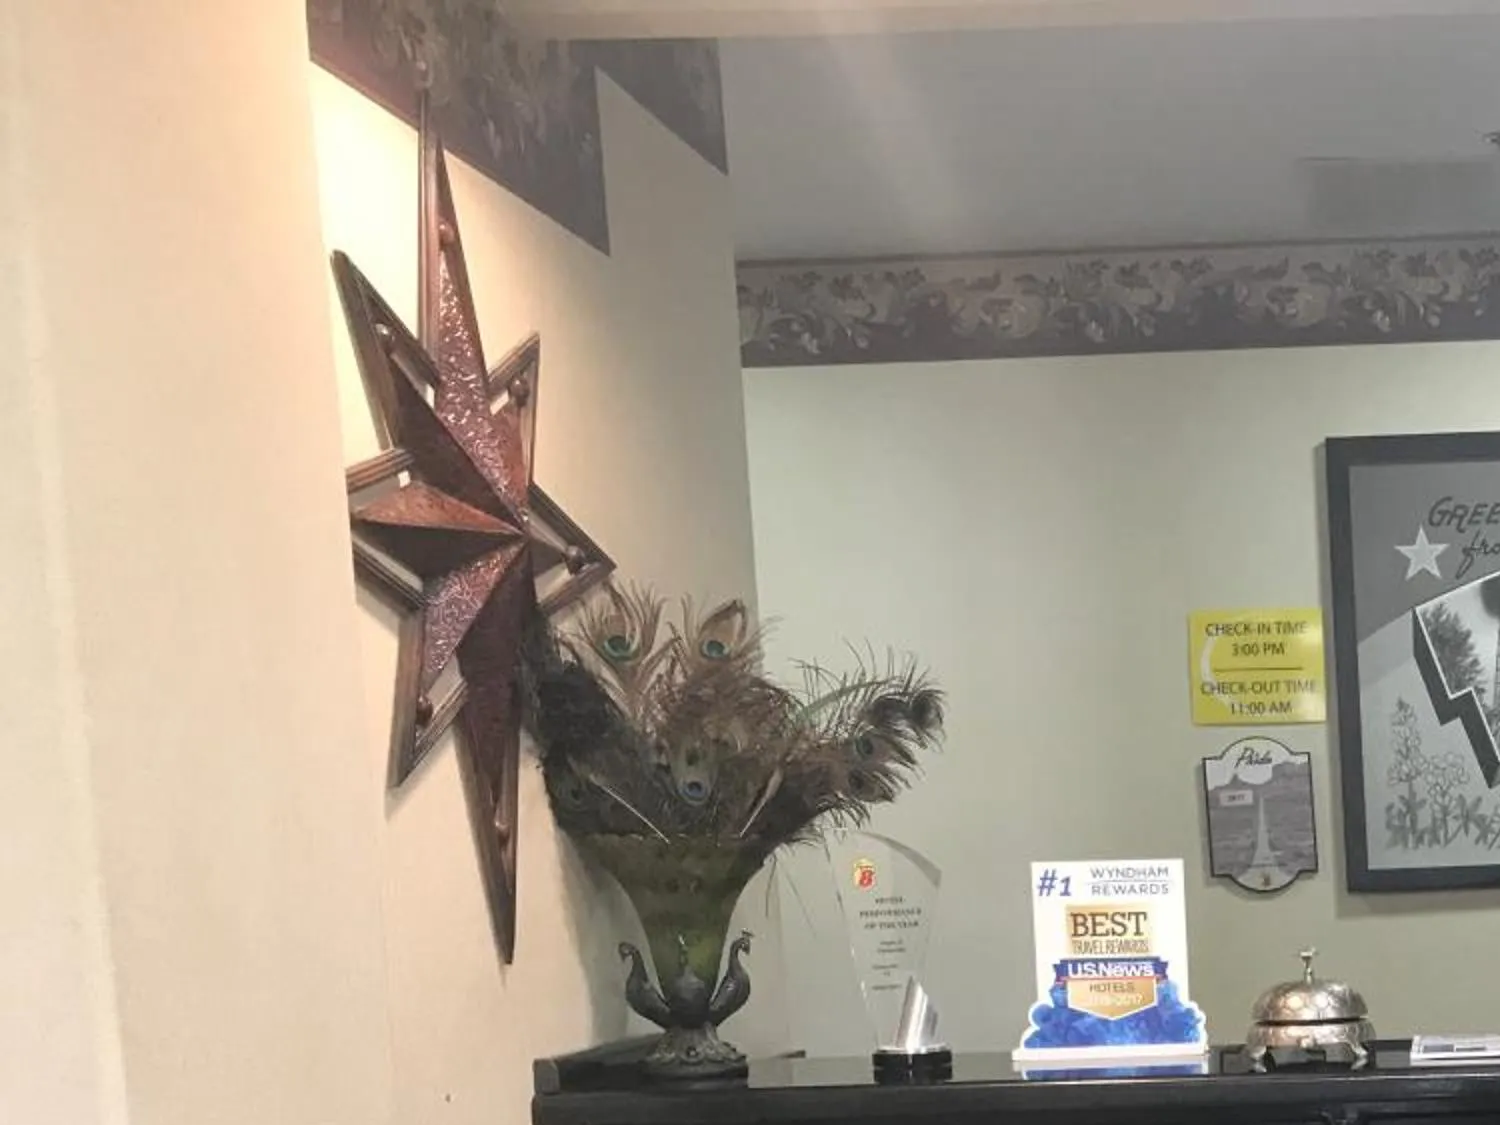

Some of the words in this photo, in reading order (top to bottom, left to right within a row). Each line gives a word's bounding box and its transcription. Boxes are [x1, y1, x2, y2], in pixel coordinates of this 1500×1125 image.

[1205, 621, 1271, 637] CHECK-IN
[1273, 620, 1309, 635] TIME
[1231, 643, 1259, 657] 3:00
[1263, 642, 1286, 656] PM
[1201, 680, 1280, 696] CHECK-OUT
[1282, 679, 1317, 694] TIME
[1230, 702, 1265, 716] 11:00
[1268, 701, 1293, 715] AM
[1038, 868, 1072, 897] #1
[1090, 865, 1169, 879] WYNDHAM
[1091, 882, 1169, 896] REWARDS
[1070, 911, 1148, 937] BEST
[1089, 981, 1136, 993] HOTELS
